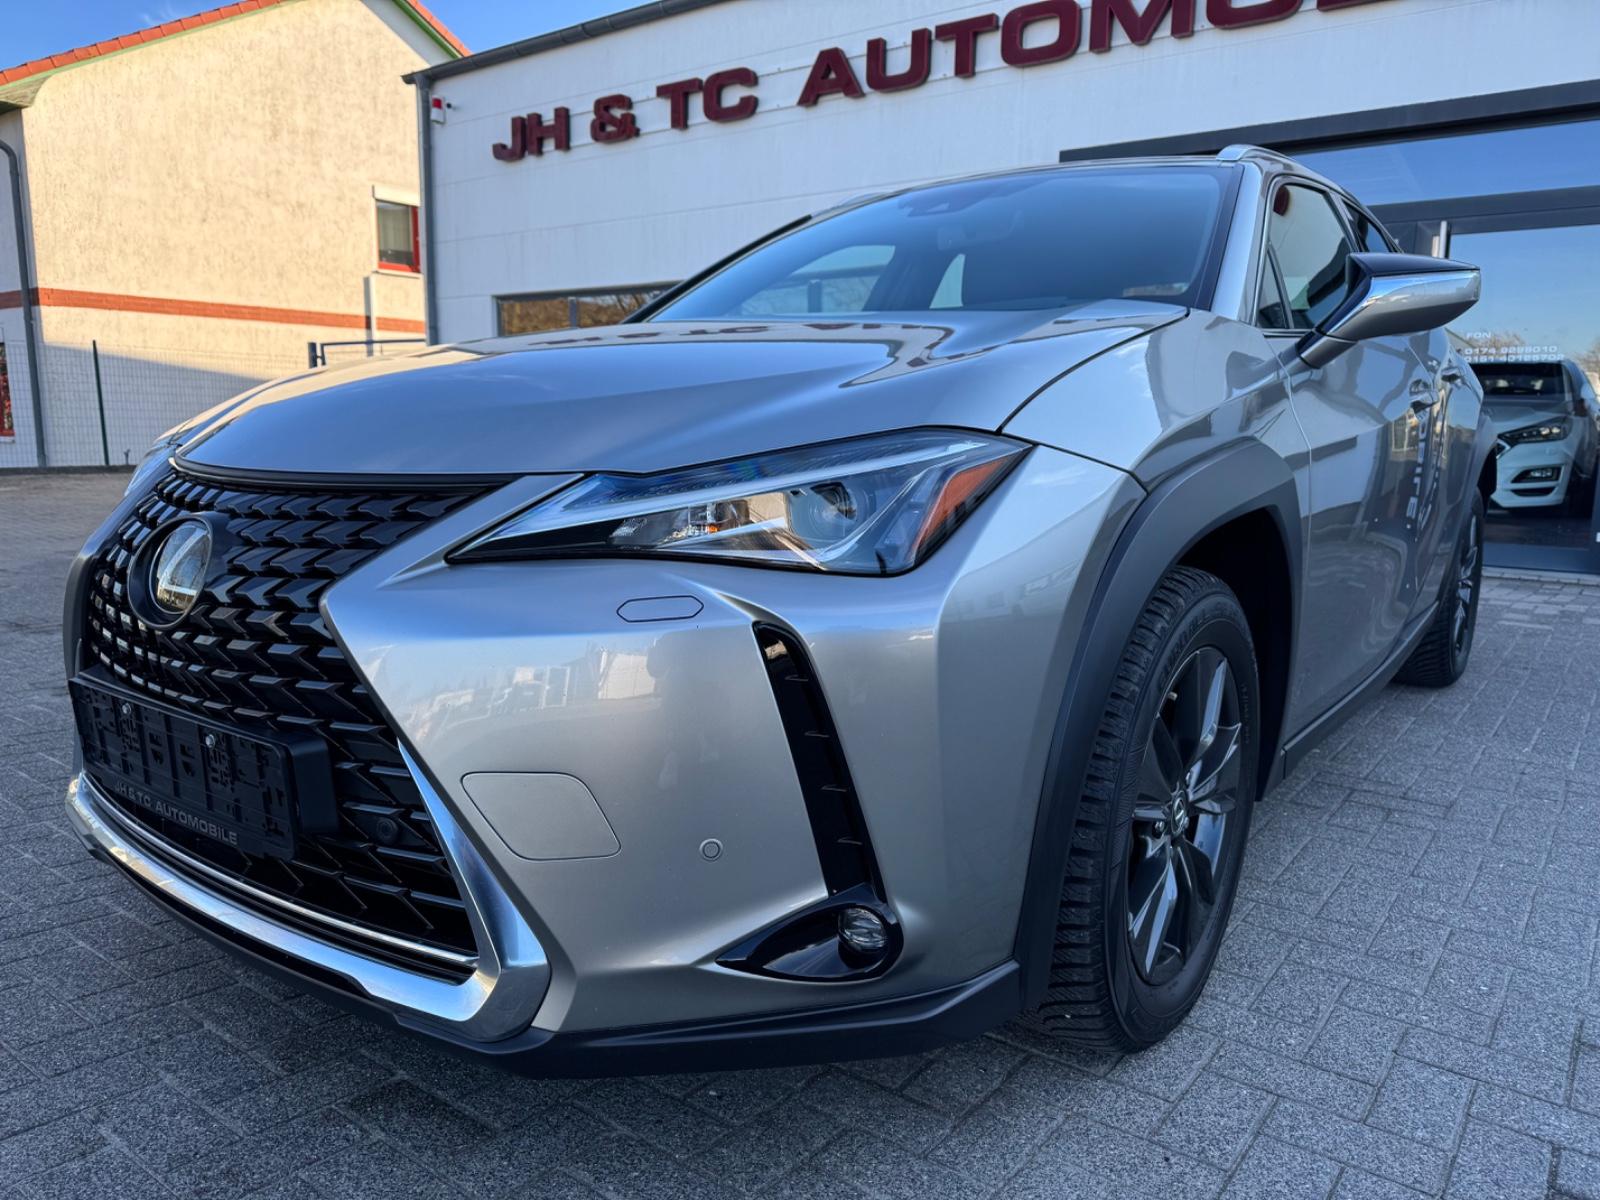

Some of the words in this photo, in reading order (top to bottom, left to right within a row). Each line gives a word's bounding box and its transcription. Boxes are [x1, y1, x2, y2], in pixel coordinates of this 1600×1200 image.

[492, 106, 571, 163] JH
[590, 93, 641, 145] &
[656, 66, 759, 130] TC
[796, 0, 1398, 109] AUTOM
[155, 800, 238, 846] AUTOMOBILE
